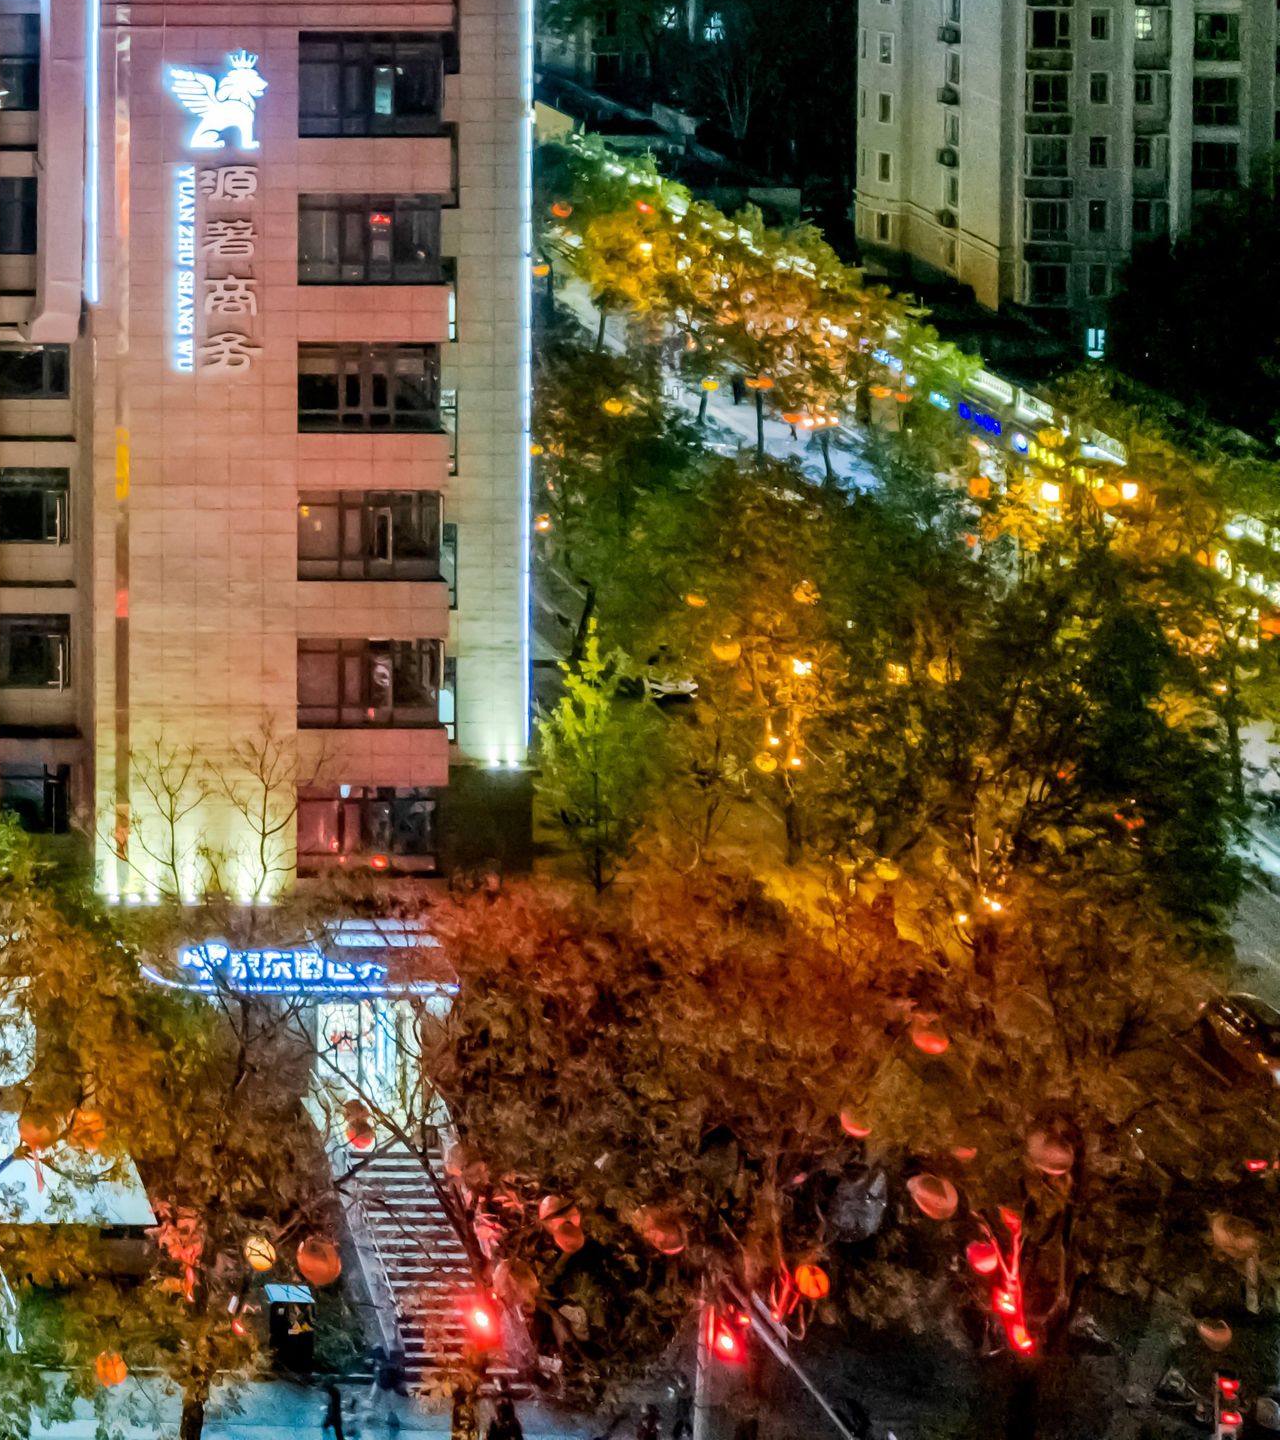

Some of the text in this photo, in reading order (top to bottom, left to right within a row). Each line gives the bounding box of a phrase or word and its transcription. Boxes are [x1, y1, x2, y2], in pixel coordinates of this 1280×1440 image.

[177, 166, 196, 372] YUAN ZHU SHANG WU
[199, 165, 263, 371] 源著商务
